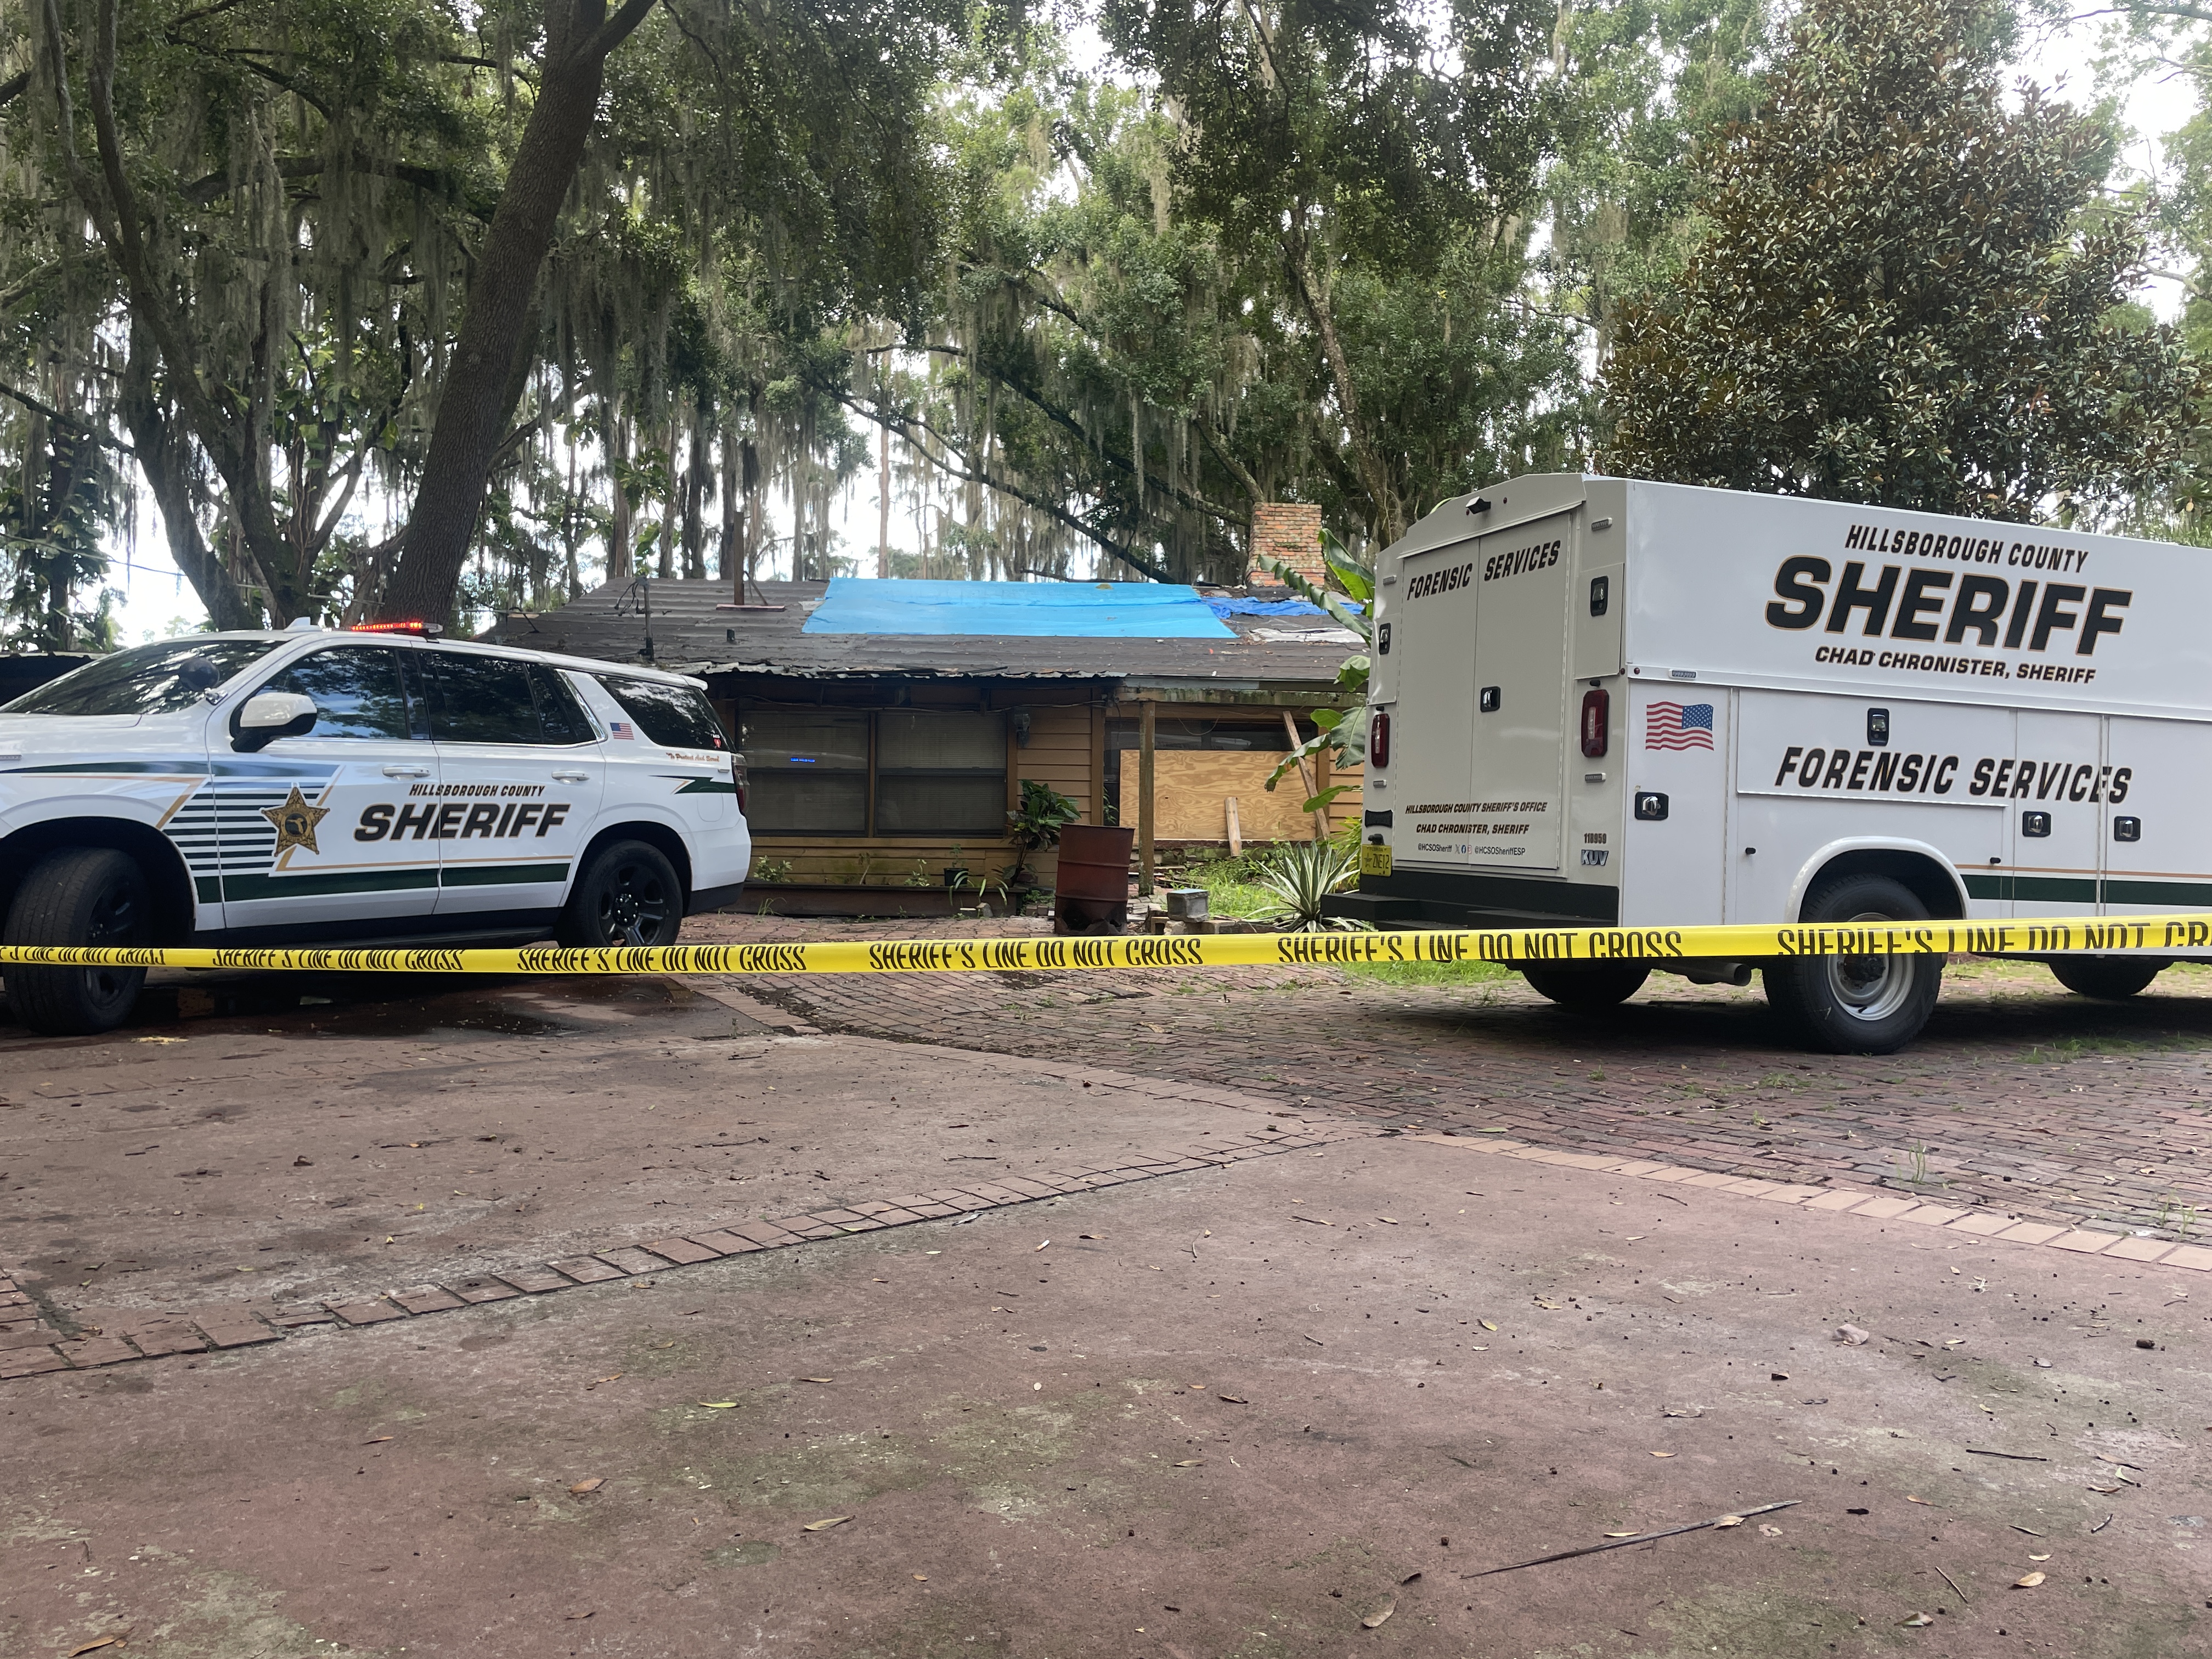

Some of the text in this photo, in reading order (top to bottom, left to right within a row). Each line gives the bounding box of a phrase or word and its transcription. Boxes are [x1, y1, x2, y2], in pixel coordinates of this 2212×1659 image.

[1844, 524, 2089, 573] HILLSBOROUGH COUNTY
[1407, 540, 1561, 601] FORENSIC SERVICES
[1765, 555, 2134, 657] SHERIFF
[1815, 646, 2096, 684] CHAD CHRONISTER, SHERIFF
[409, 783, 545, 797] HILLSBOROUGH COUNTY
[1775, 746, 2132, 804] FORENSIC SERVICES
[353, 803, 571, 842] SHERIFF
[1405, 802, 1548, 814] HILLSBOROUGH COUNTY SHERIFF'S OFFICE
[1416, 824, 1530, 835] CHAD CHRONISTER, SHERIFF
[1418, 843, 1452, 853] @HCSOSheriff
[1581, 849, 1609, 866] KUV
[870, 938, 1204, 970] SHERIFF'S LINE DO NOT CROSS
[1277, 934, 1402, 962] SHERIFF'S
[1481, 933, 1513, 960] DO
[1525, 933, 1578, 959] NOT
[1589, 932, 1683, 958] CROSS
[1778, 927, 1933, 956] SHERIFF'S
[2028, 925, 2070, 951] DO
[2085, 923, 2151, 950] NOT
[517, 945, 807, 972] SHERIFF'S LINE DO NOT CROSS
